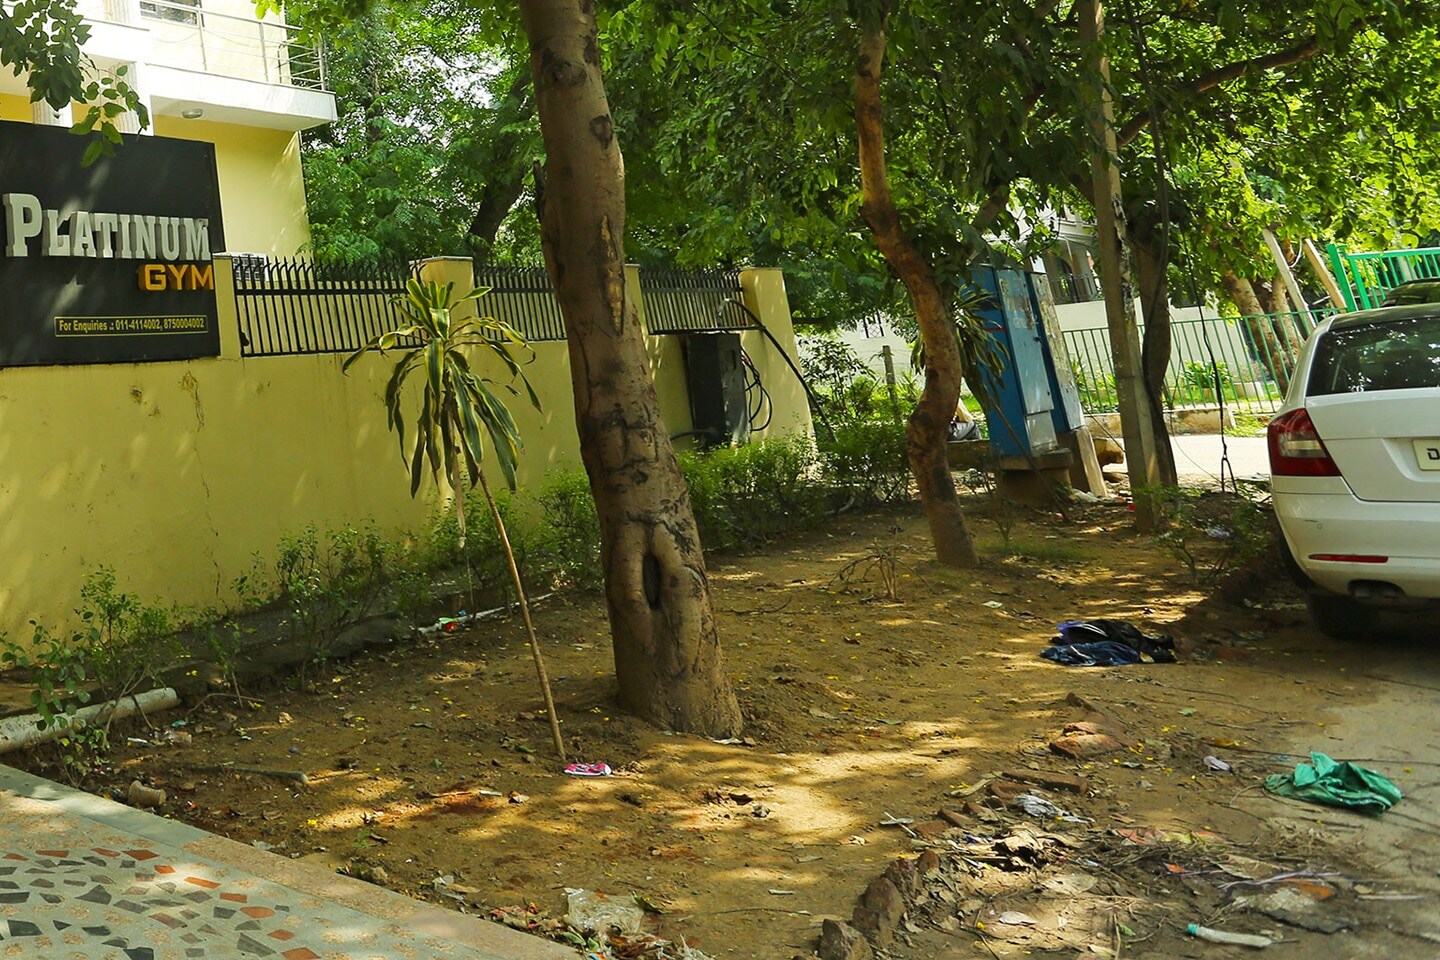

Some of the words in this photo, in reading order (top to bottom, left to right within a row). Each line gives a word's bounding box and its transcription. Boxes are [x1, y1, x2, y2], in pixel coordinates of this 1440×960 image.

[2, 192, 210, 261] PLATINUM
[139, 264, 215, 291] GYM
[59, 320, 72, 331] For
[73, 319, 108, 333] Enquiries
